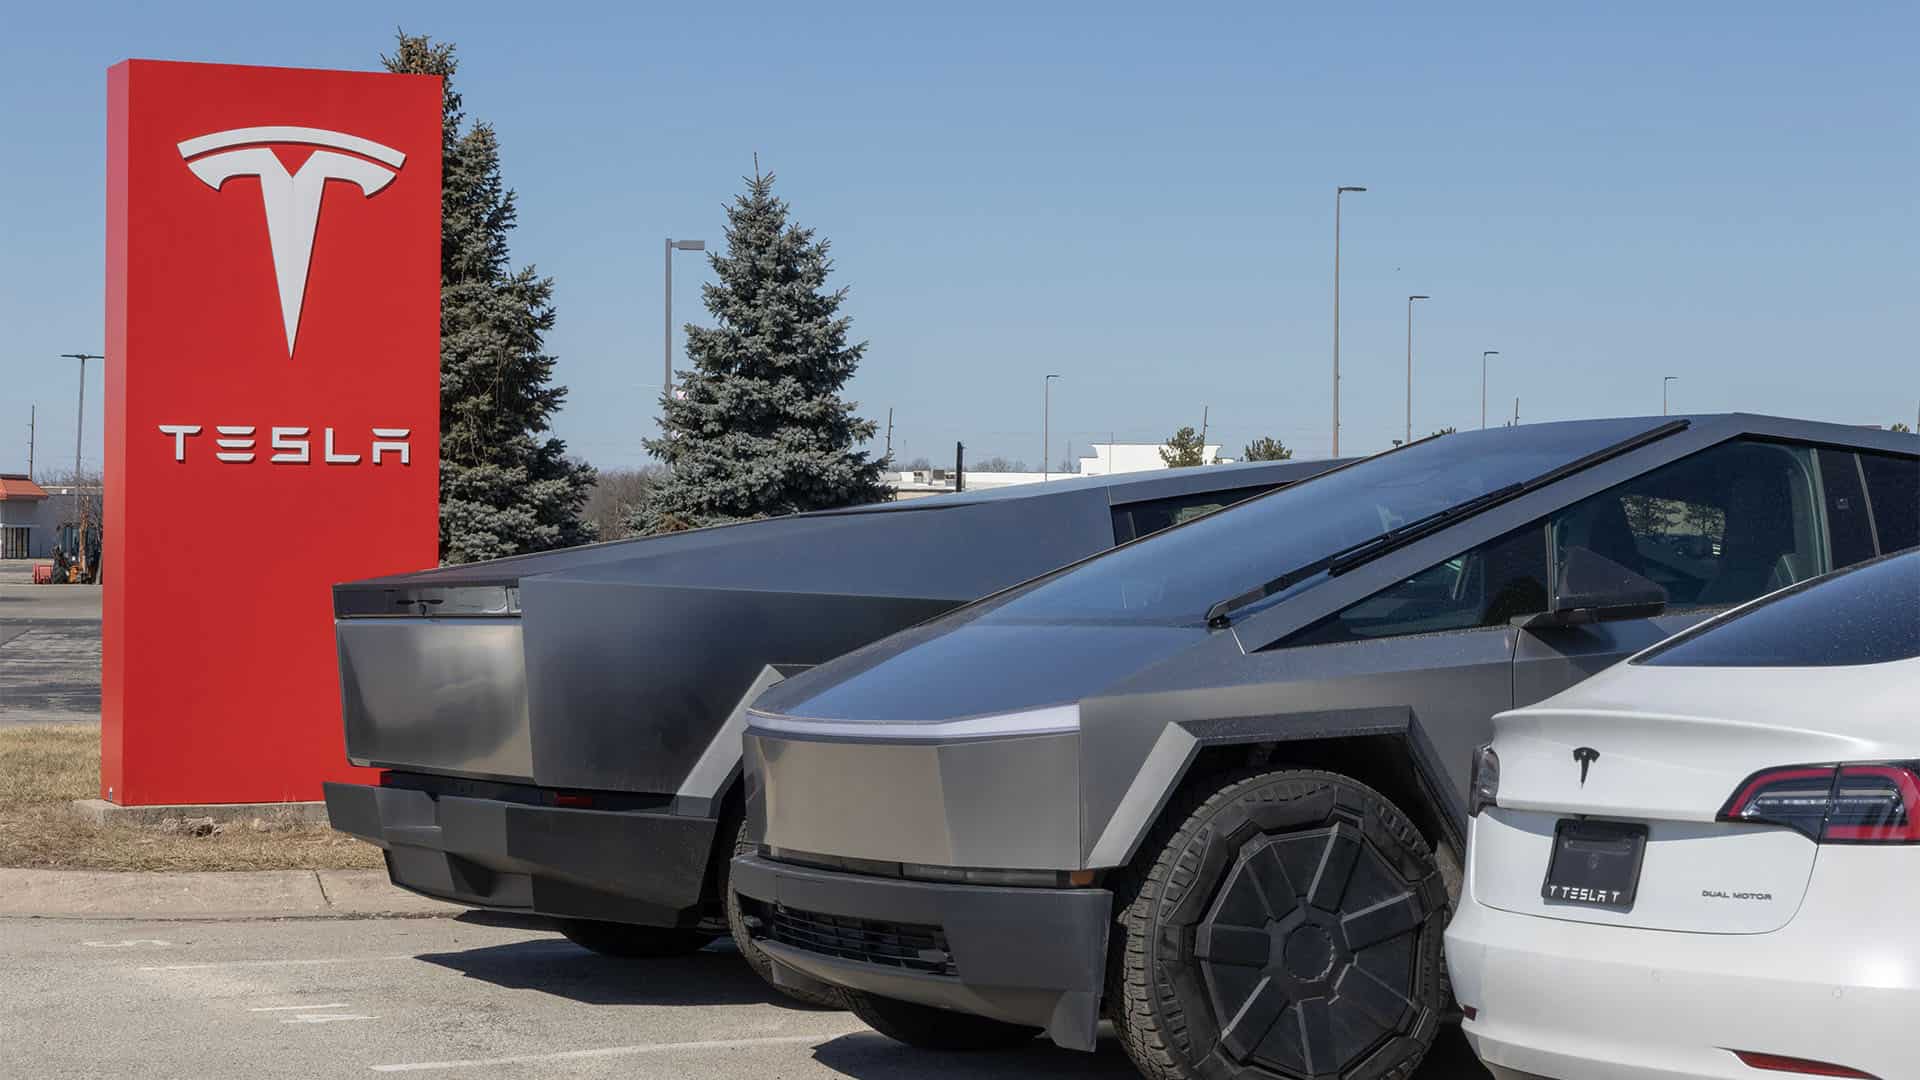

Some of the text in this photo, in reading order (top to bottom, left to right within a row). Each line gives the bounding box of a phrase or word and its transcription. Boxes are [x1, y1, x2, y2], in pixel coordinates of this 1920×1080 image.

[158, 424, 411, 464] TESLA
[1562, 886, 1607, 903] TESLA
[1702, 890, 1772, 900] DUAL MOTOR
